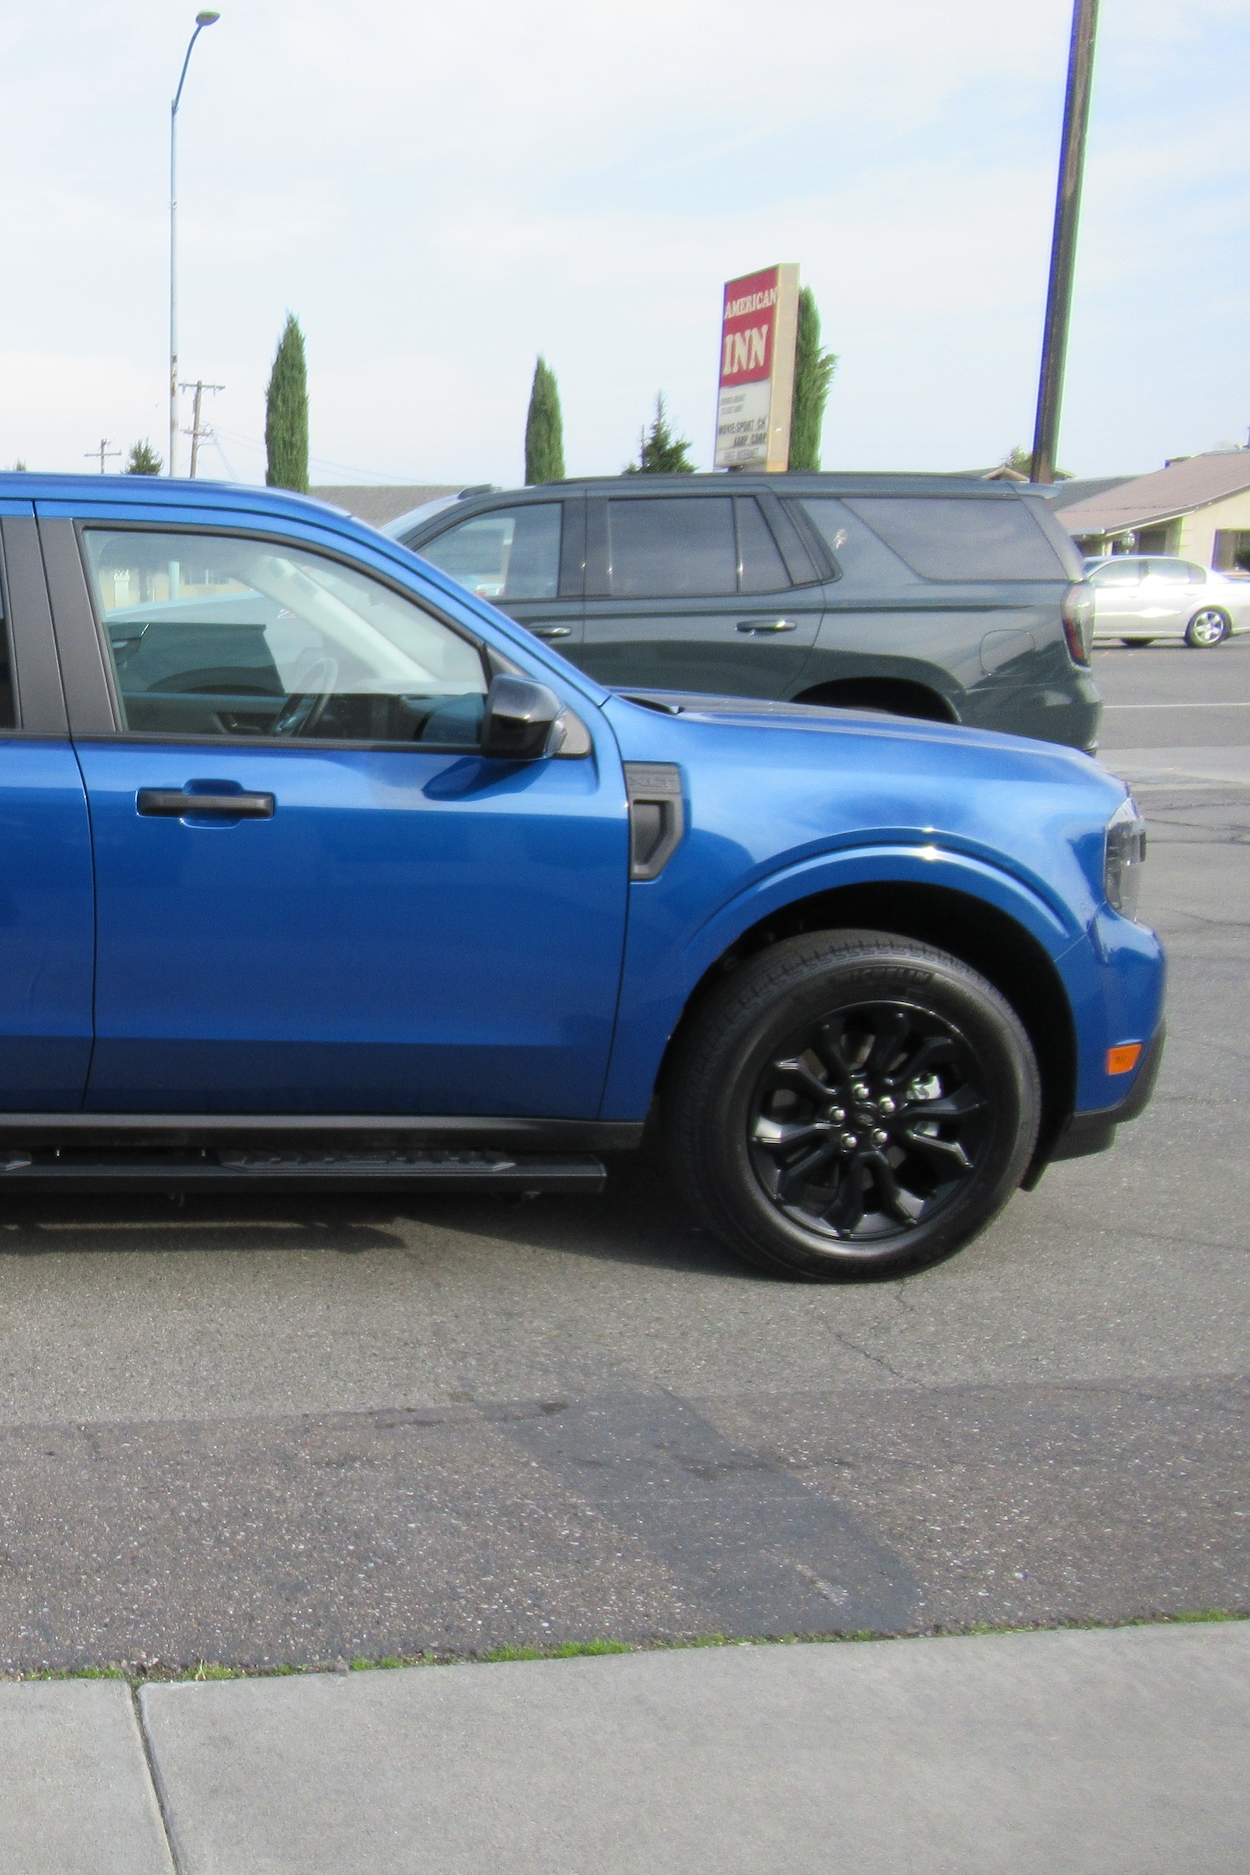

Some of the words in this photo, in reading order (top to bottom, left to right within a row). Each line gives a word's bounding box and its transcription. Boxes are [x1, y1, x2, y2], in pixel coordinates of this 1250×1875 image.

[724, 287, 777, 319] AMERICAN
[723, 324, 769, 375] INN
[751, 432, 767, 446] CORP
